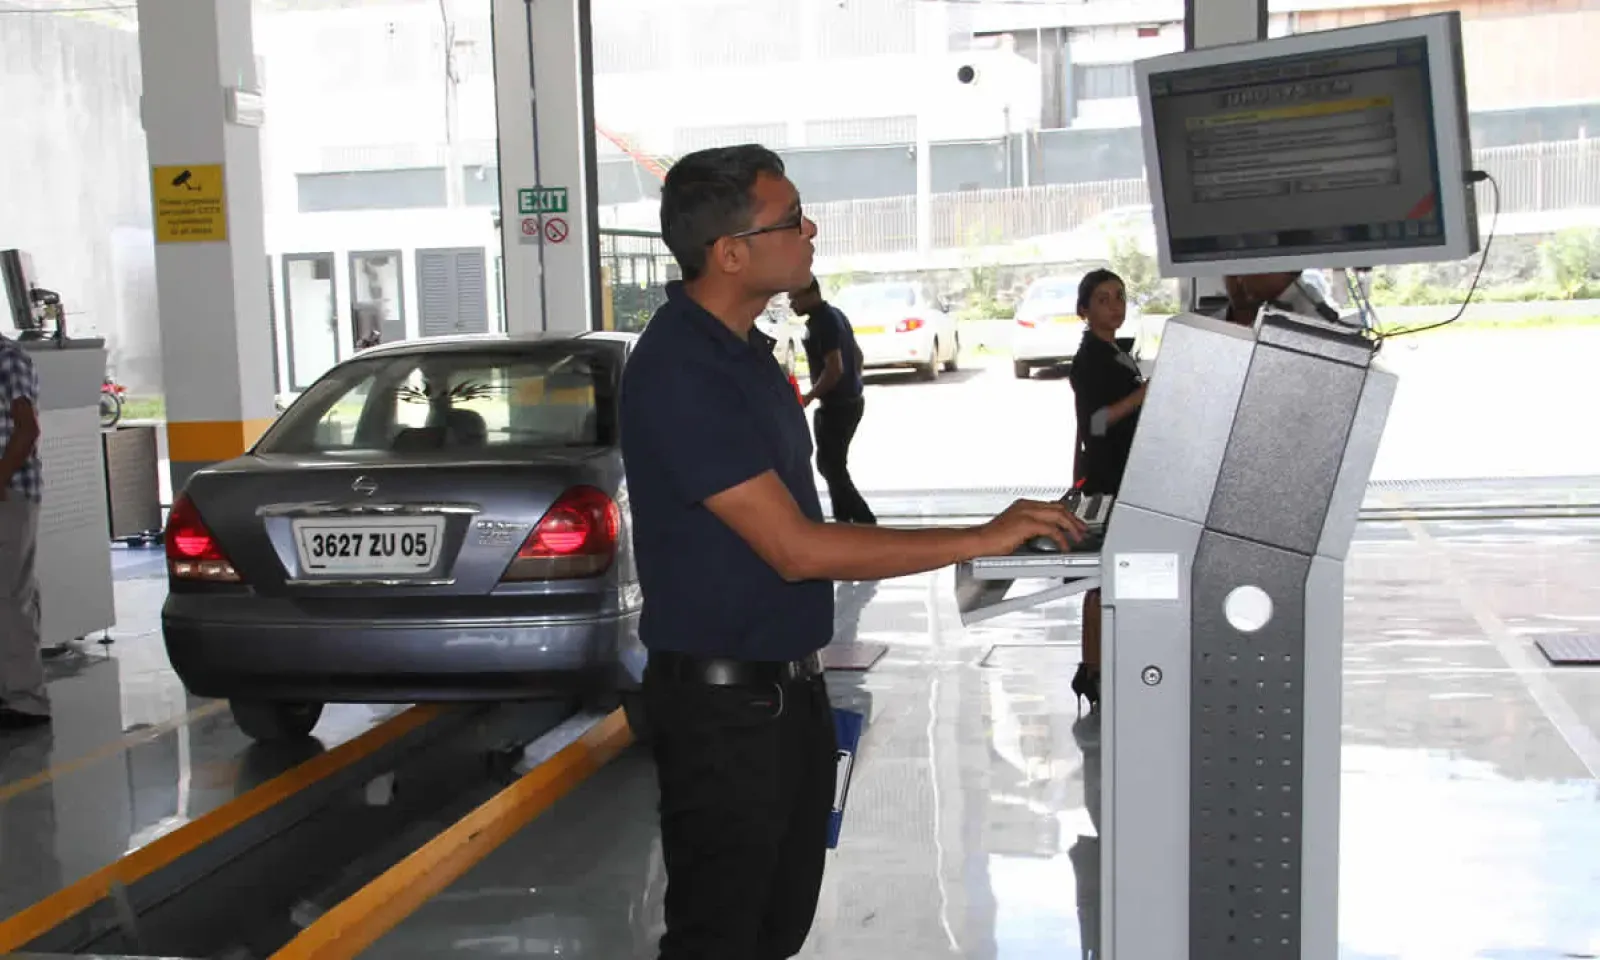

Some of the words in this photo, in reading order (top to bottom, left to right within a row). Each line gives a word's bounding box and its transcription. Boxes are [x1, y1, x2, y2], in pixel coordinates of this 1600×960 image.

[520, 189, 566, 210] EXIT
[312, 532, 363, 557] 3627
[369, 532, 396, 557] ZU
[401, 532, 427, 557] 05
